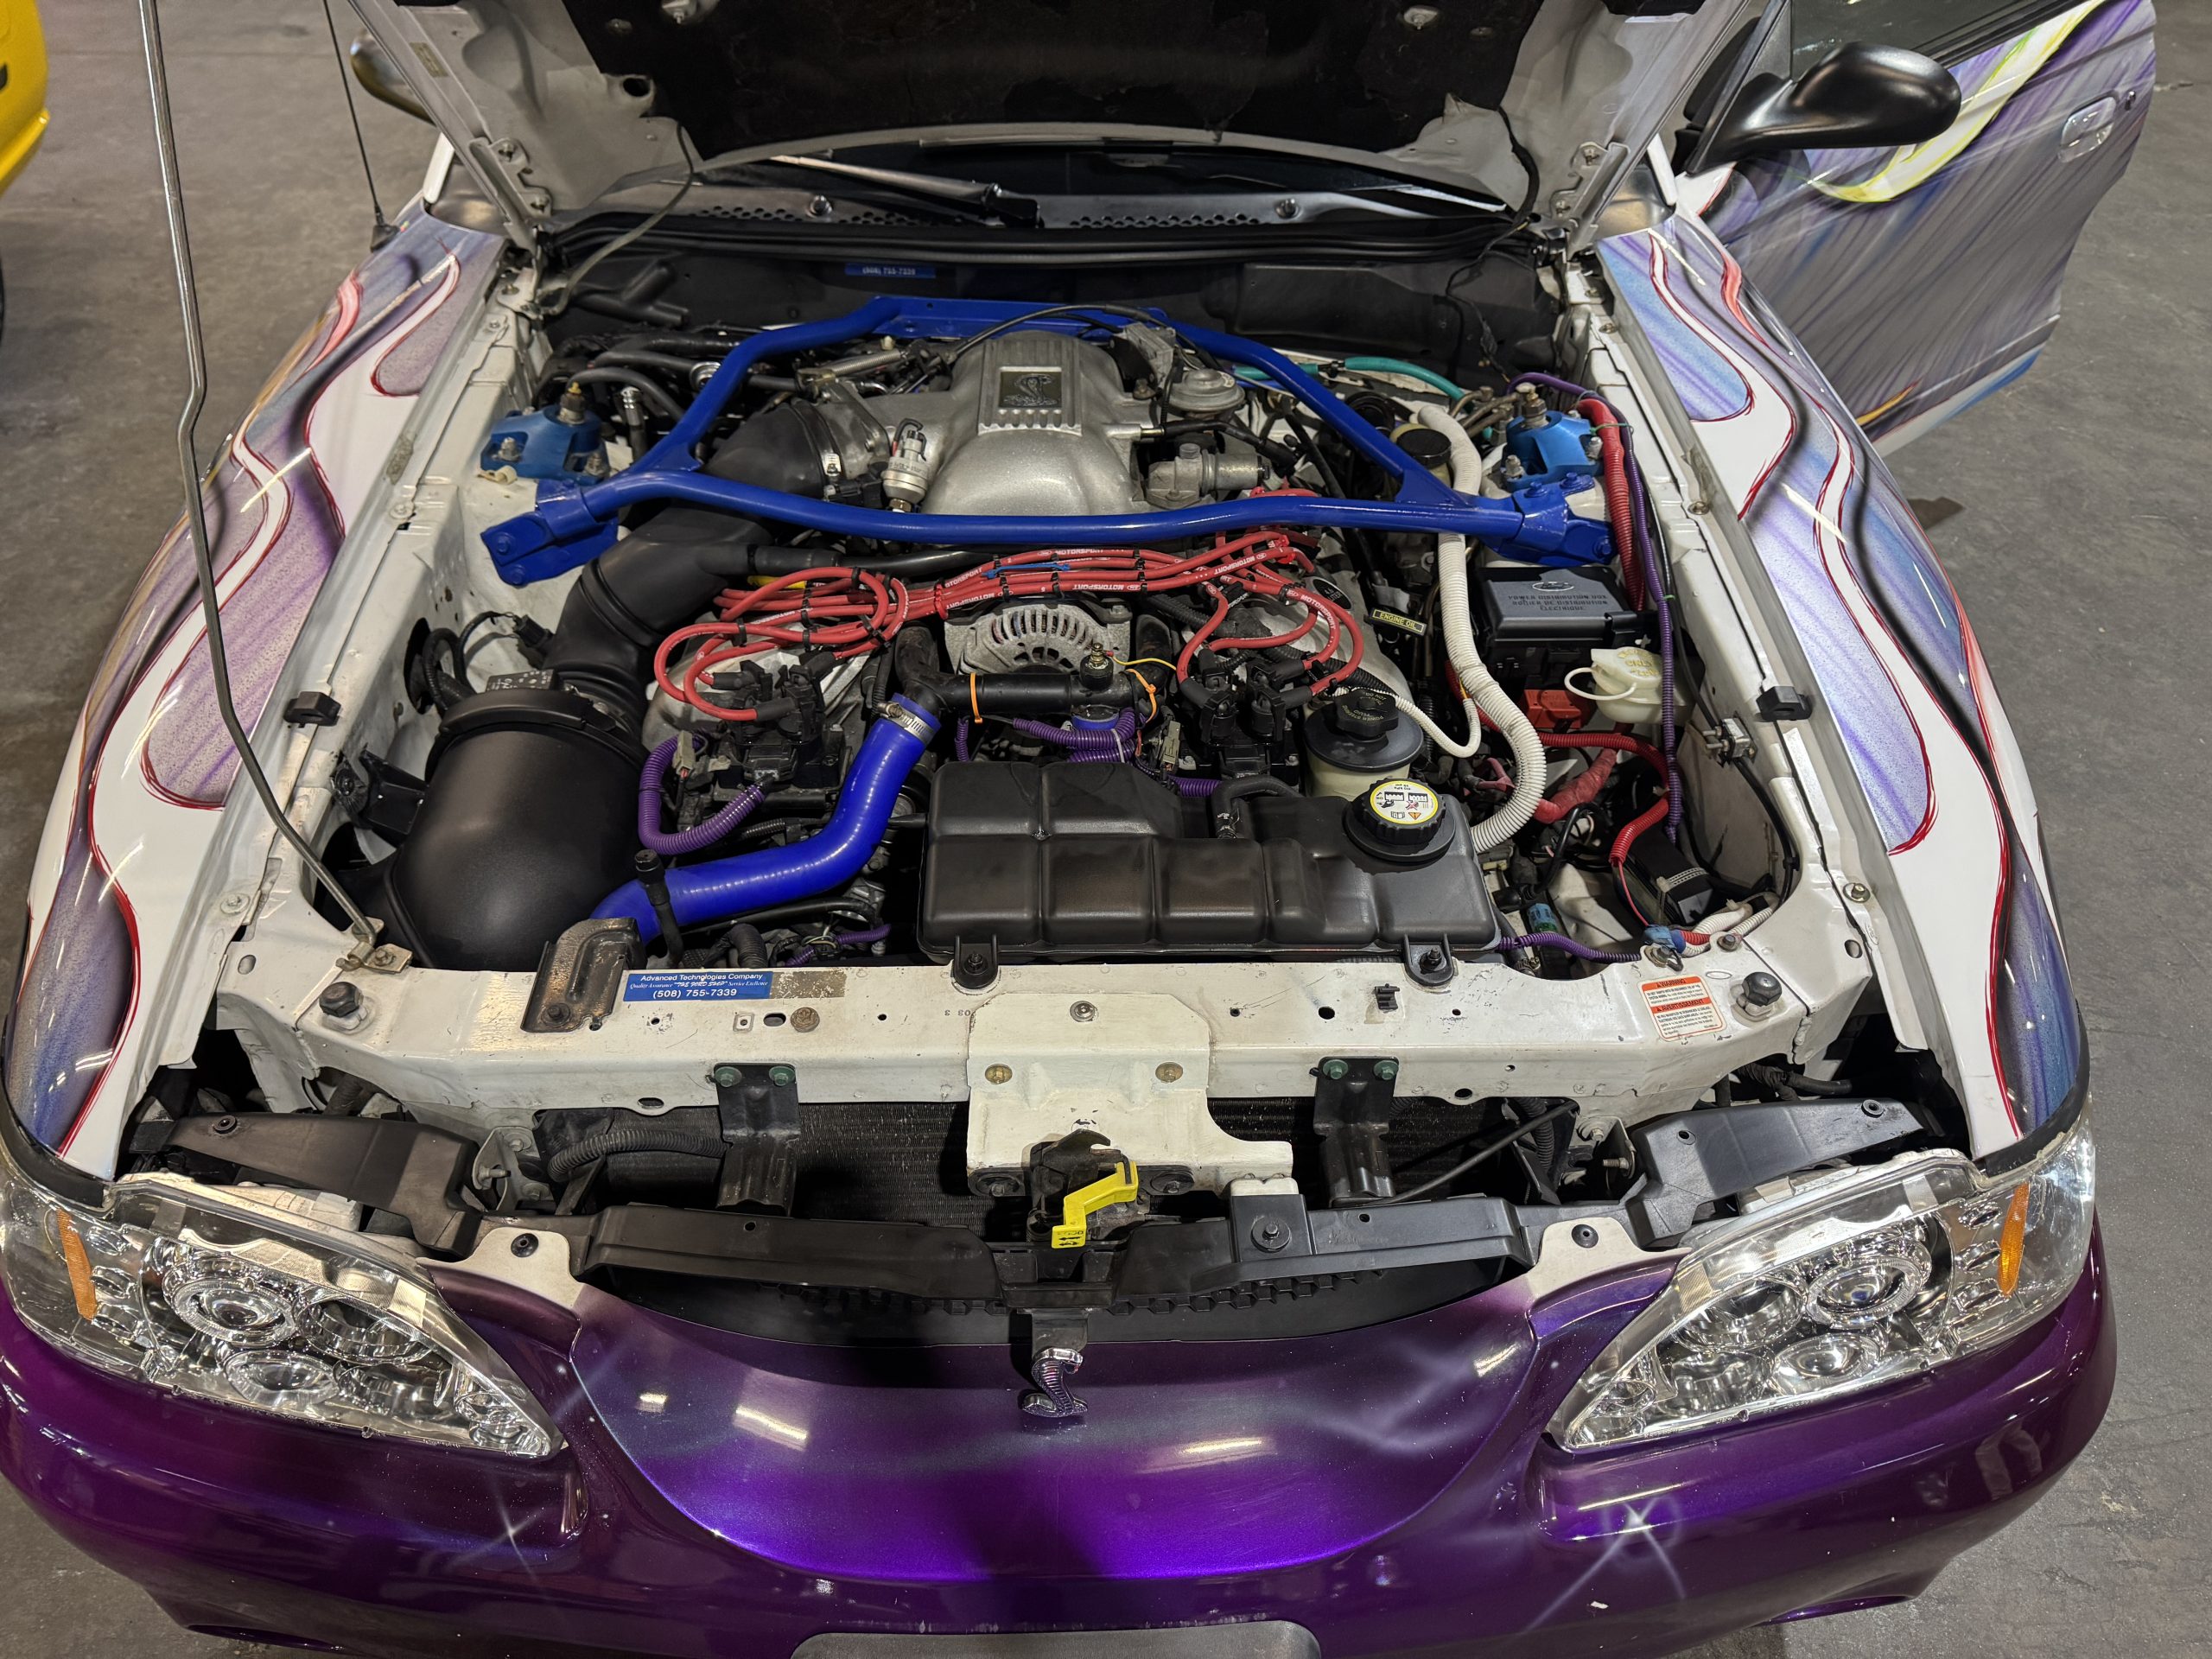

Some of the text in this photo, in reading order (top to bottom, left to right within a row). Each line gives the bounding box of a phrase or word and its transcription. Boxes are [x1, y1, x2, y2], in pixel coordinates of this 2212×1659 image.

[946, 592, 995, 610] MOTORSPORT
[1300, 594, 1336, 630] MOTORSPORT
[1379, 613, 1405, 626] ENGINE
[1661, 978, 1687, 987] WARNING
[652, 988, 737, 999] (508) 755-7339
[1662, 999, 1705, 1012] AVERTISSEMENT
